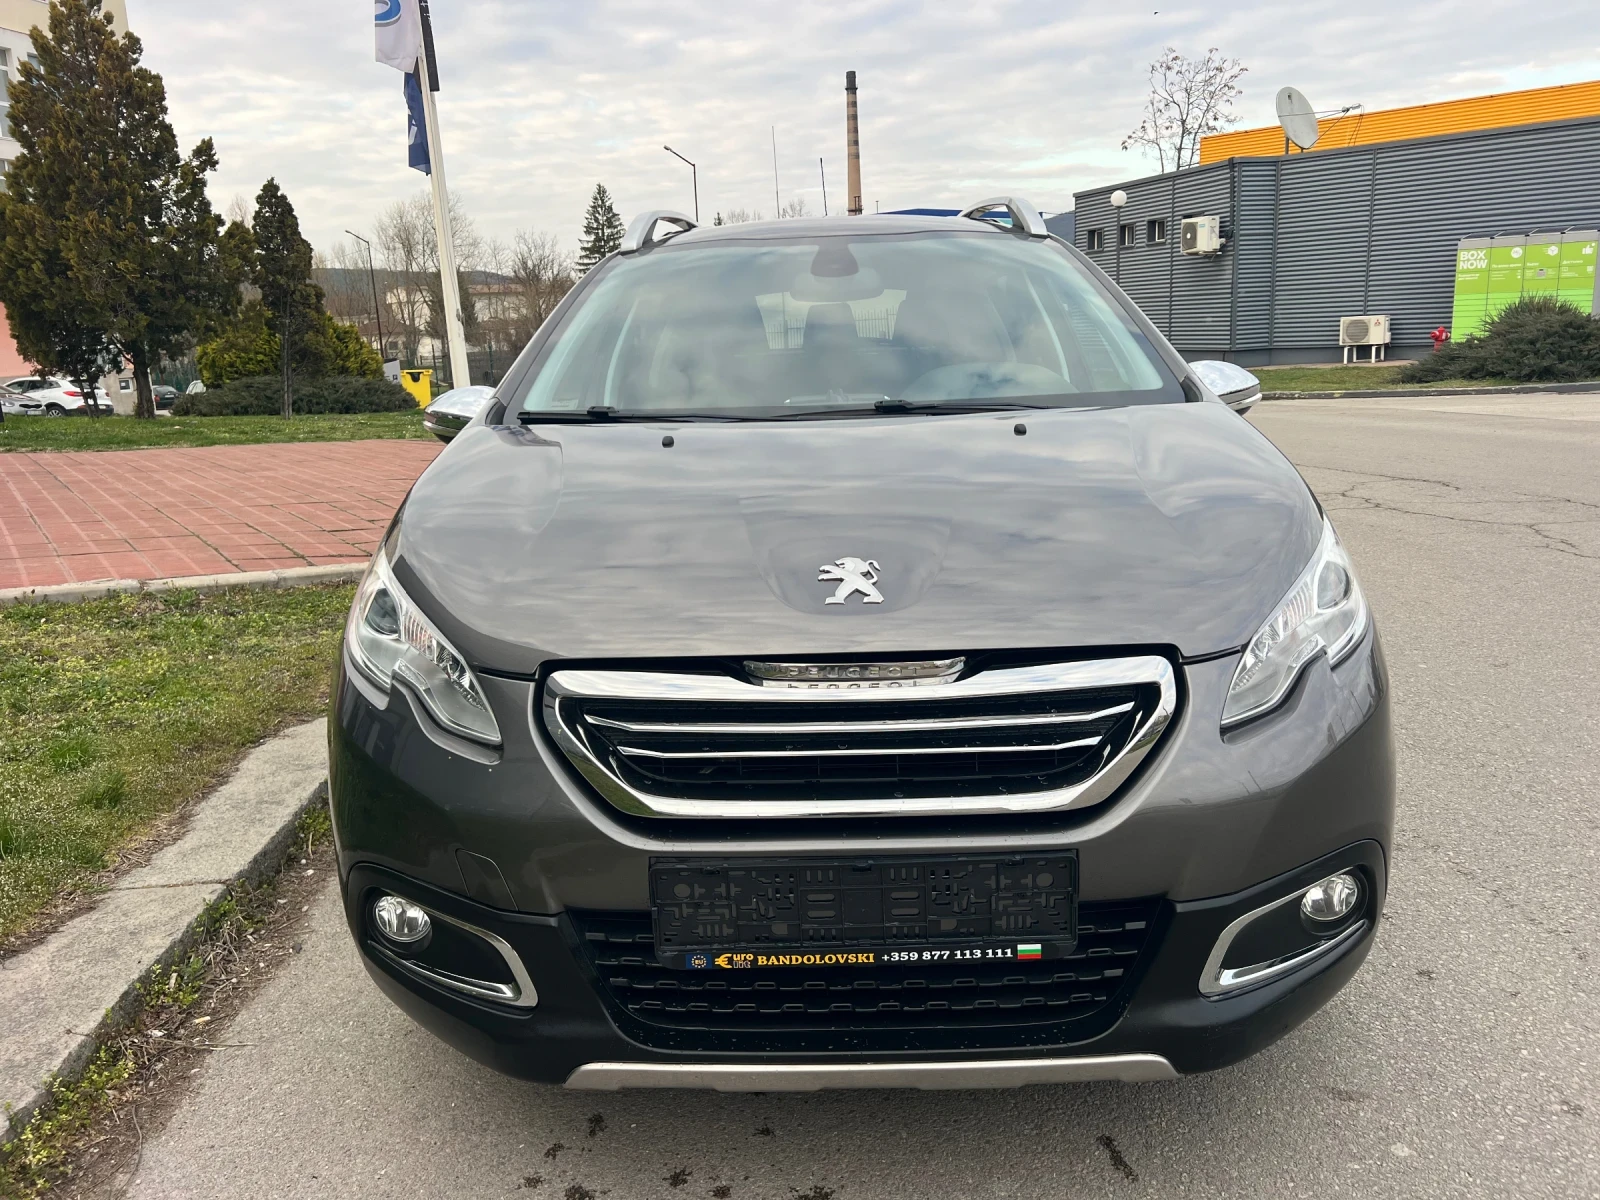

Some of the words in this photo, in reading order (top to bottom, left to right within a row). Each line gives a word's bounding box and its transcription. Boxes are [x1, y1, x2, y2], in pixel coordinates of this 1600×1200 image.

[1460, 250, 1486, 260] BOX
[1459, 259, 1488, 270] NOW
[787, 666, 920, 678] PEUGEOT
[757, 953, 875, 966] BANDOLOVSKI
[881, 951, 919, 962] +359
[921, 950, 950, 961] 877
[953, 949, 982, 960] 113
[985, 948, 1014, 959] 111
